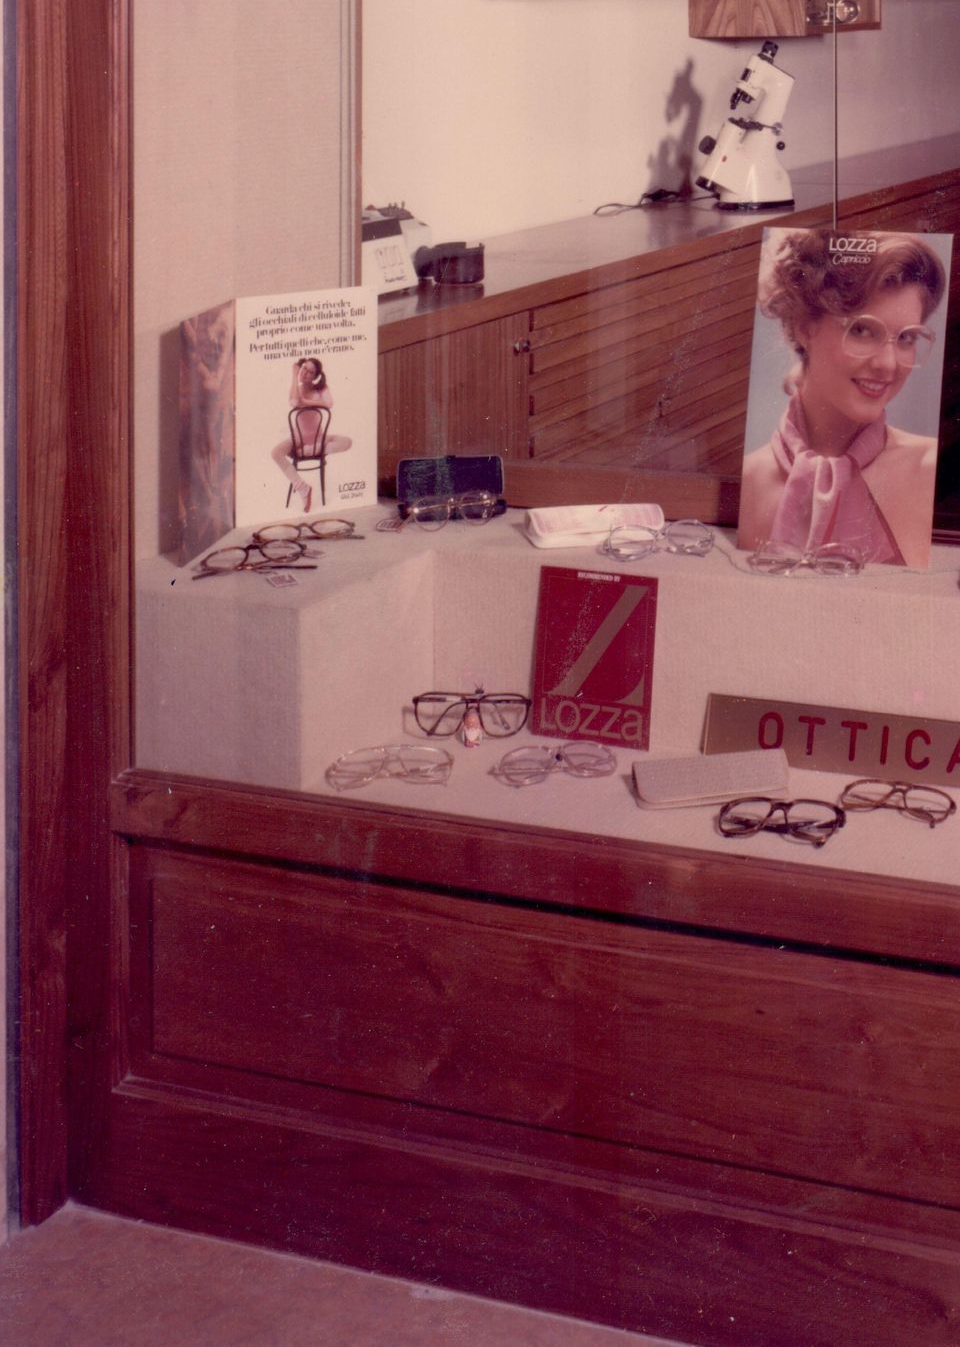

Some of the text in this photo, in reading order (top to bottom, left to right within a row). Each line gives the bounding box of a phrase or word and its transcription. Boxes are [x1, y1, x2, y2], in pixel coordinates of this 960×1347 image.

[262, 313, 297, 326] occhiali
[350, 306, 366, 317] fatti
[256, 326, 288, 339] proprio
[290, 325, 314, 333] come
[284, 337, 309, 350] quelli
